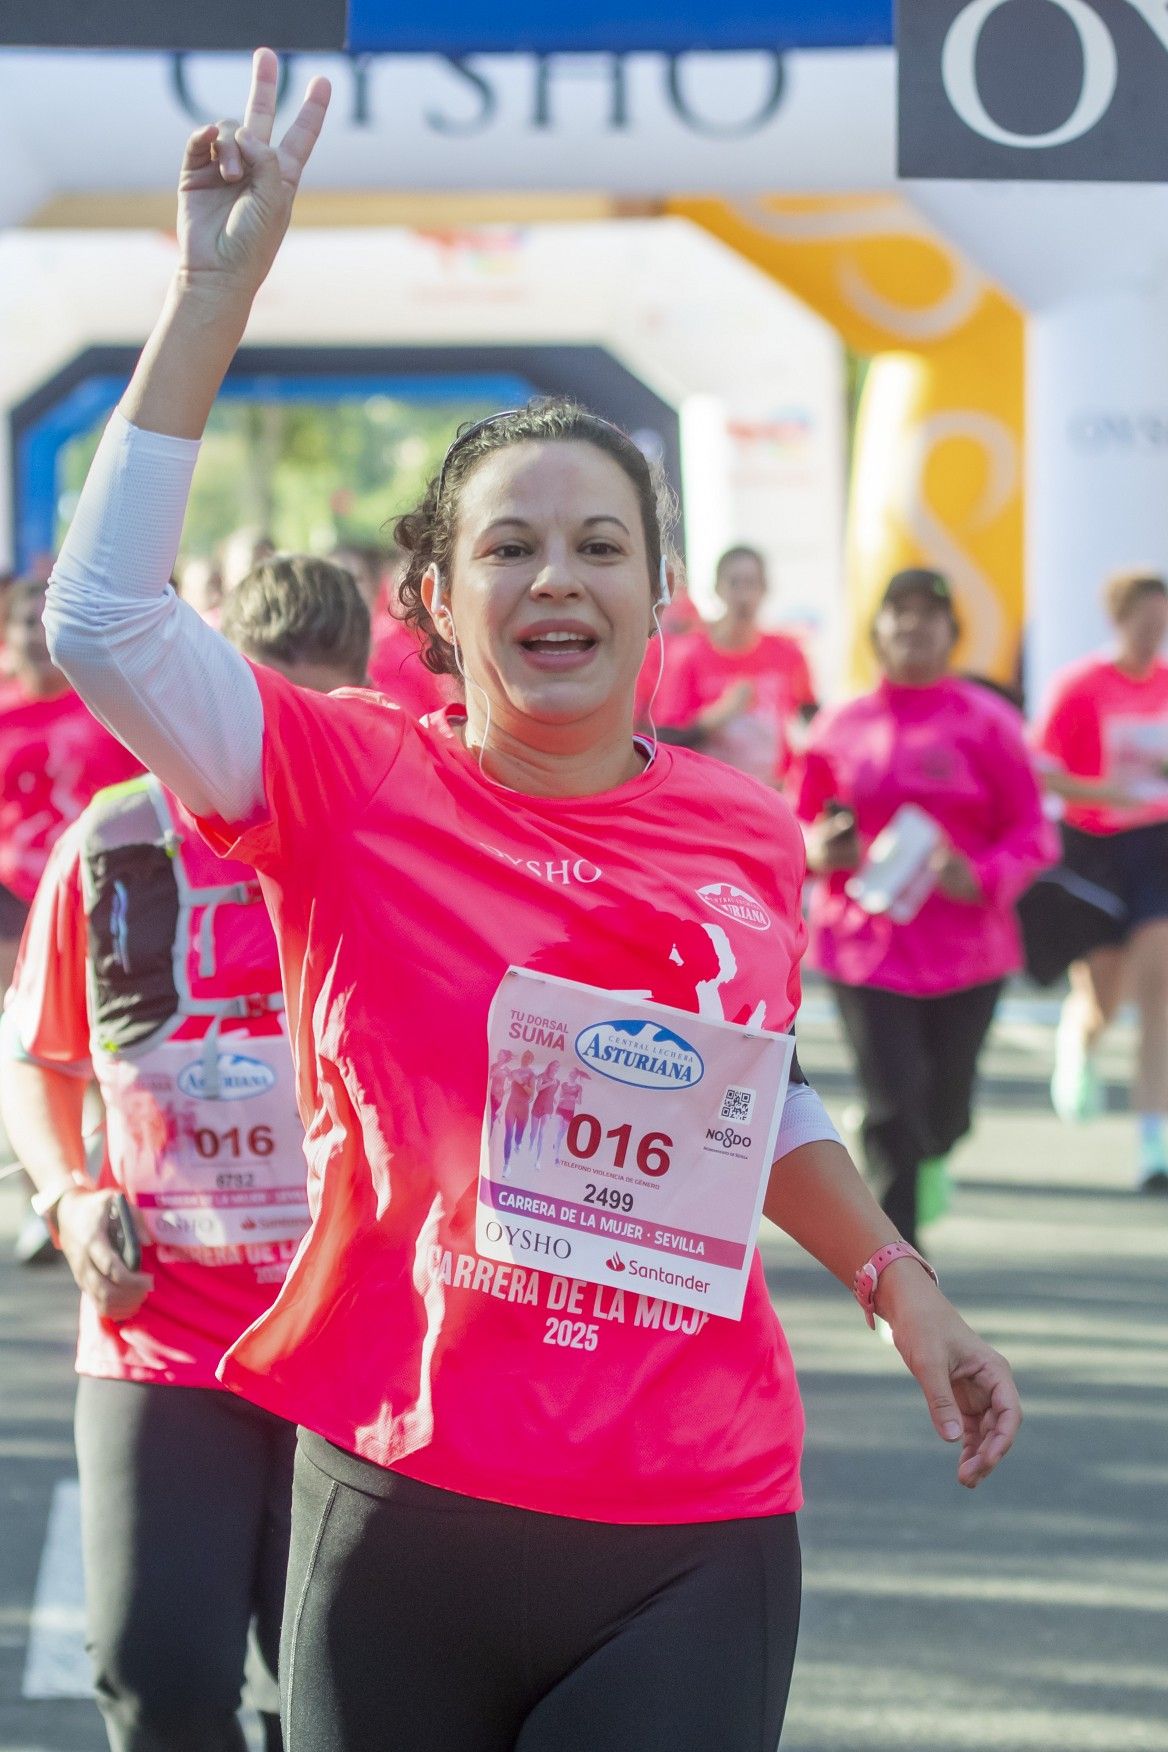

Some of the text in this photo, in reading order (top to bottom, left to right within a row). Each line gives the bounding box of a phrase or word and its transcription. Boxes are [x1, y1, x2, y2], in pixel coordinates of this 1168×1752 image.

[508, 1022, 566, 1052] SUMA
[510, 1009, 569, 1034] TU DORSAL
[583, 1032, 692, 1083] ASTURIANA
[608, 1035, 694, 1063] CENTRAL LECHERA
[195, 1125, 275, 1158] 016
[566, 1113, 674, 1177] 016
[583, 1183, 634, 1212] 2499
[486, 1221, 572, 1259] OYSHO
[499, 1191, 705, 1255] CARRERA DE LA MUJER SEVILLA
[629, 1260, 711, 1294] Santander
[547, 1276, 588, 1315] DE
[593, 1284, 626, 1324] LA
[543, 1317, 600, 1352] 2025
